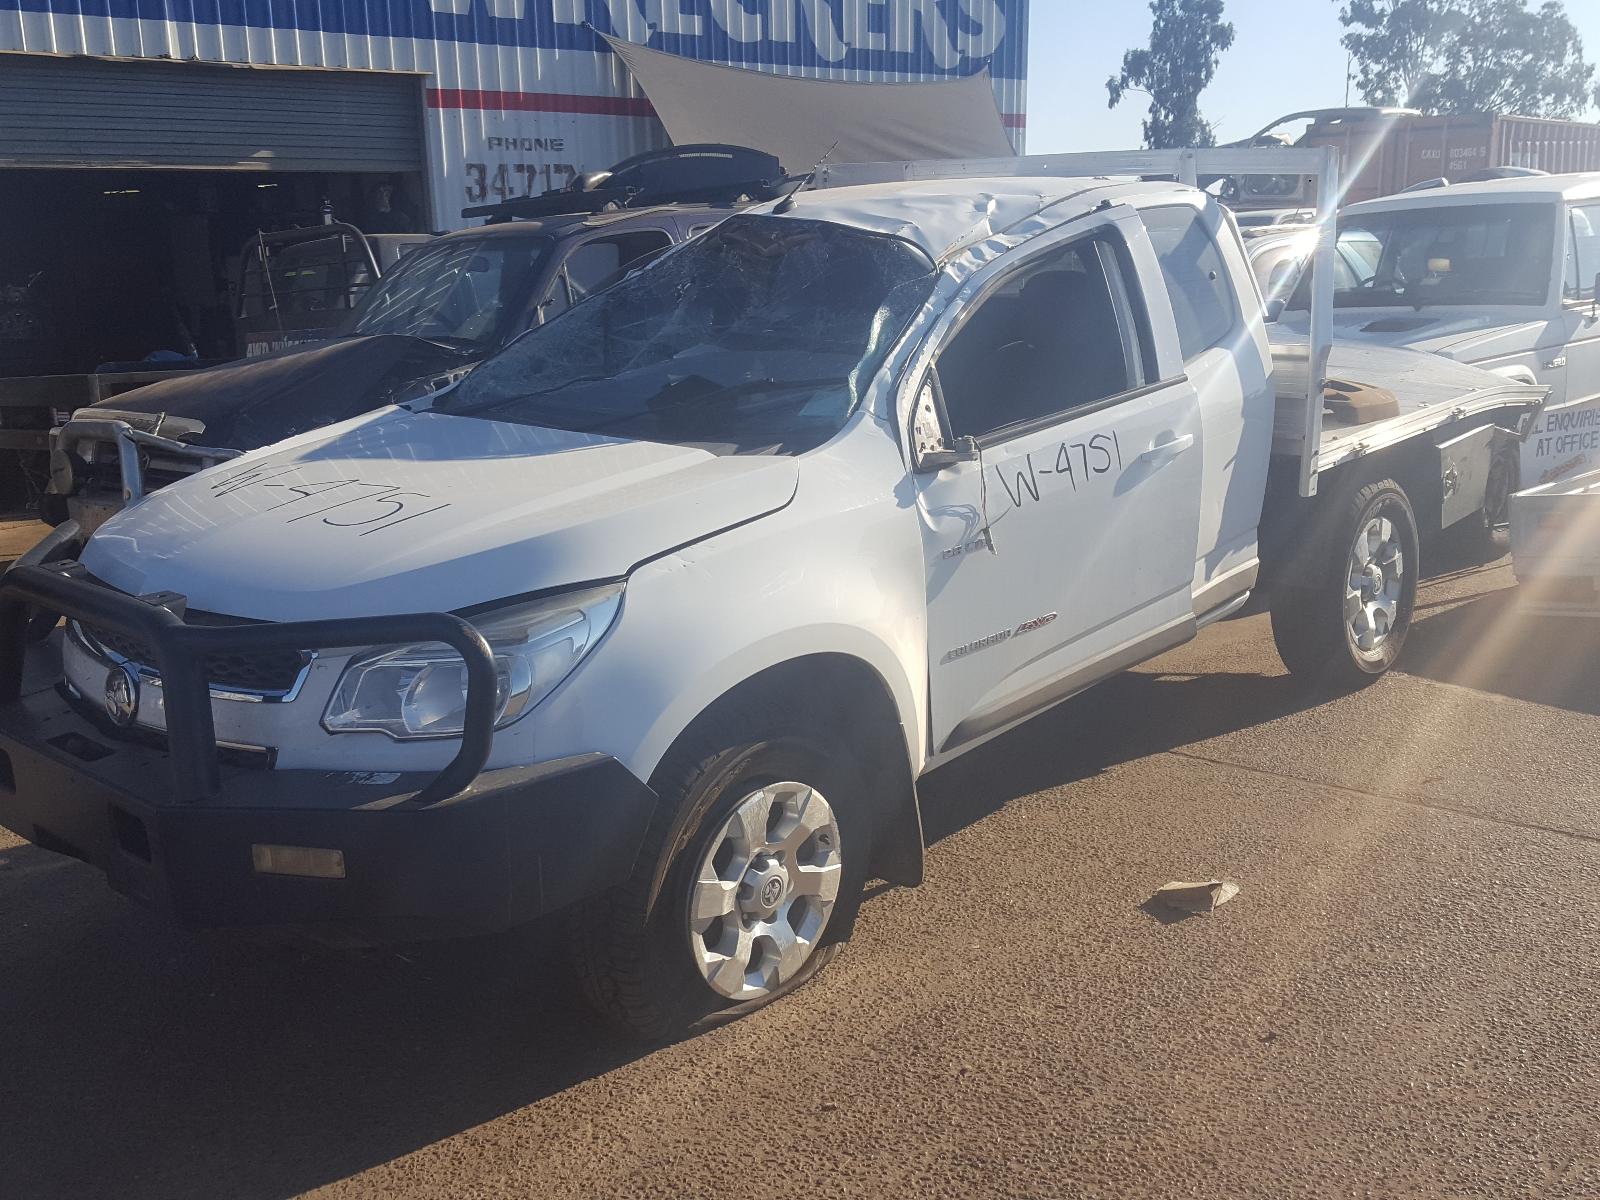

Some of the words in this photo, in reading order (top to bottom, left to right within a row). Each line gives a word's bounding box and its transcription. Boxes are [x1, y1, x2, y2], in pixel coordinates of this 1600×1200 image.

[487, 136, 564, 152] PHONE
[1536, 438, 1551, 457] AT
[1555, 430, 1599, 453] OFFICE
